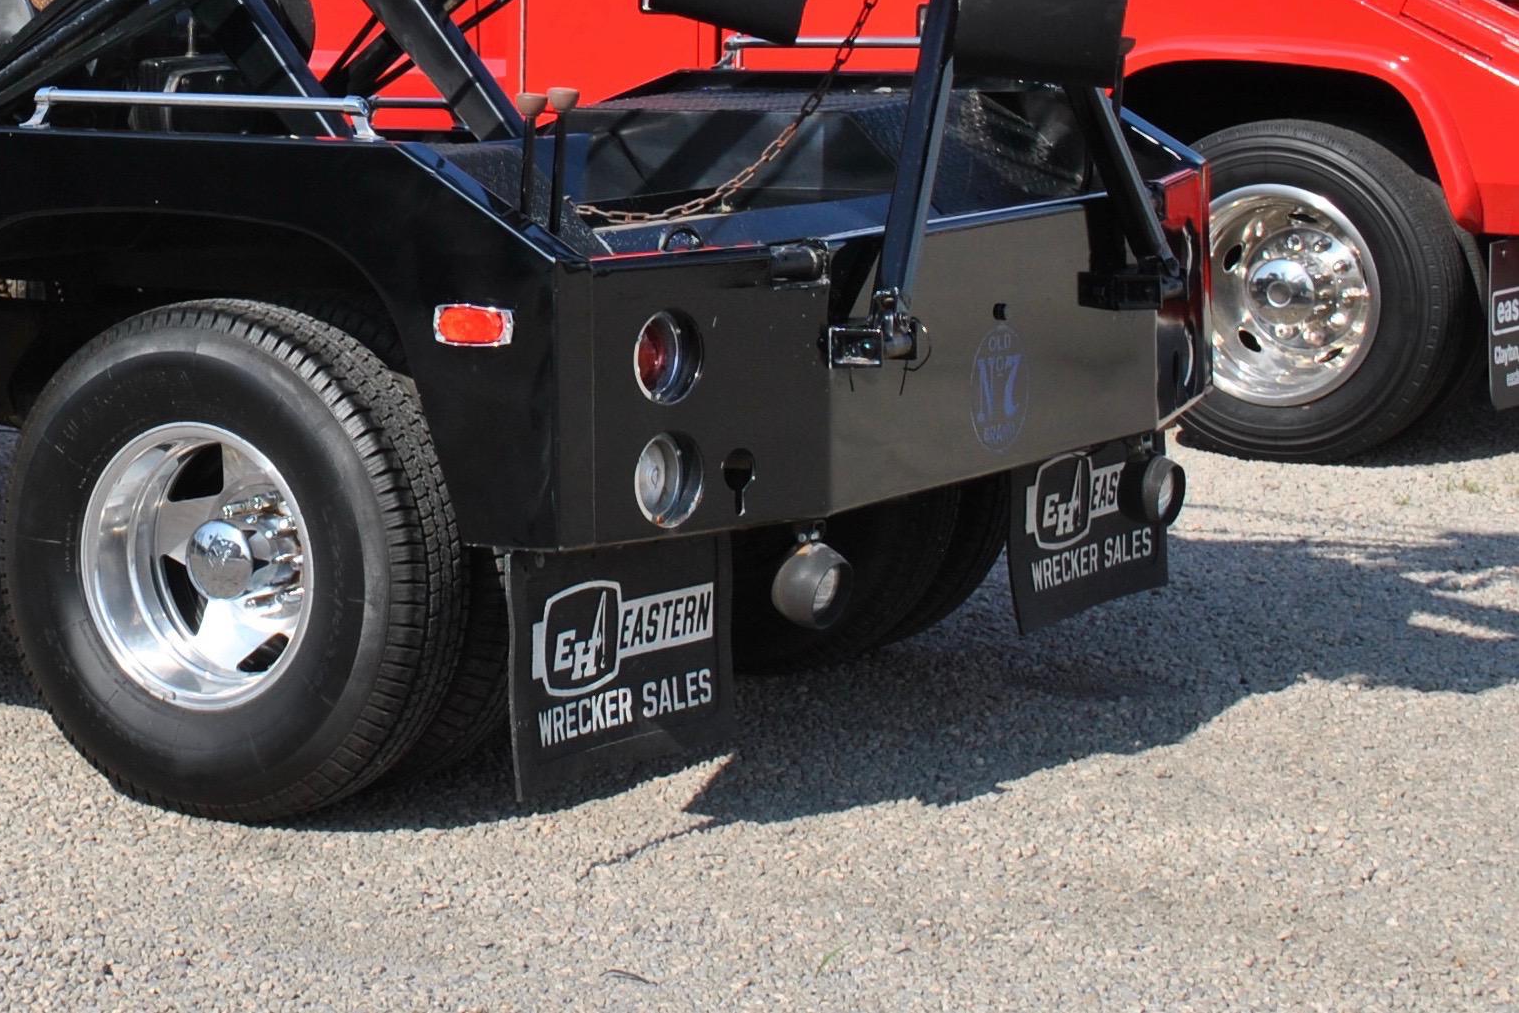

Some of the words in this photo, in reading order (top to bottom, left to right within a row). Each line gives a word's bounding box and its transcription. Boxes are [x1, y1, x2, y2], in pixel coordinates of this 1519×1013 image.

[1091, 470, 1119, 511] EAS
[1031, 543, 1098, 592] WRECKER
[1104, 527, 1152, 568] SALES
[619, 591, 712, 650] EASTERN
[538, 687, 633, 748] WRECKER
[642, 668, 712, 718] SALES
